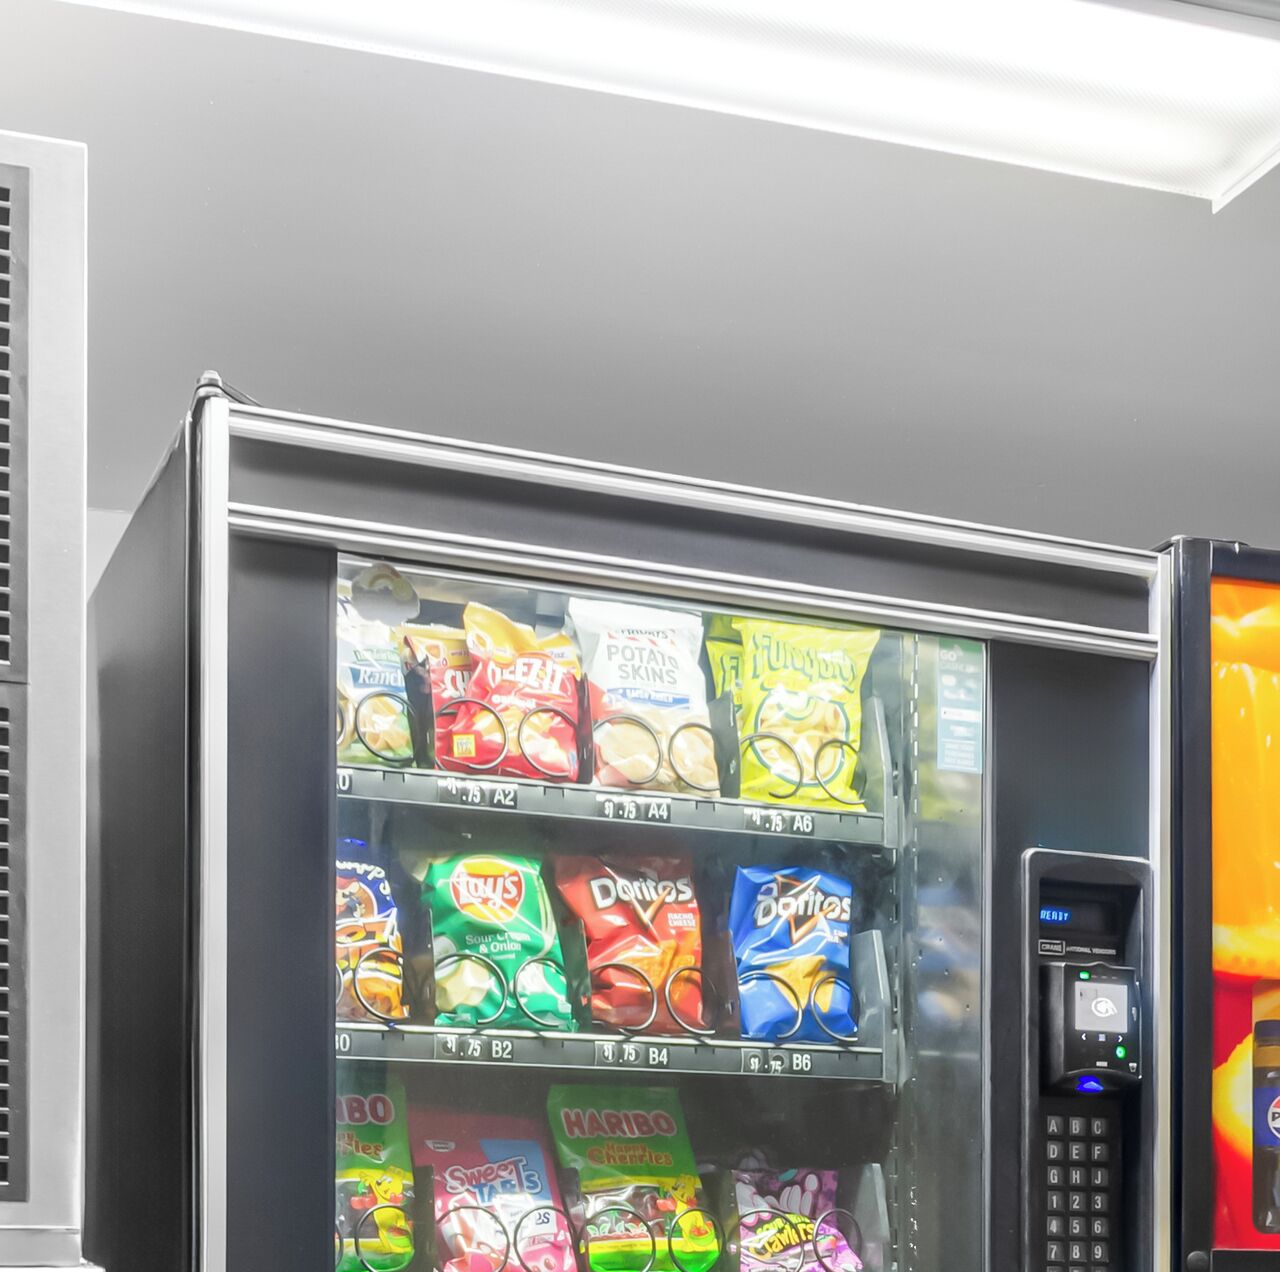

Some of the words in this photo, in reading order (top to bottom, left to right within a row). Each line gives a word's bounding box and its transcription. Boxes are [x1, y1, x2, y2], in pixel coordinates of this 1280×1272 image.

[607, 644, 679, 670] POTATO
[618, 664, 678, 685] SKINS
[336, 772, 350, 791] 0
[494, 788, 515, 806] A2
[648, 801, 668, 820] A4
[792, 814, 813, 833] A6
[590, 877, 693, 910] Doritos
[754, 885, 852, 927] Doritos
[1039, 909, 1069, 921] READY
[466, 933, 493, 946] Sour
[479, 944, 488, 954] &
[491, 941, 522, 953] Onion
[492, 1041, 512, 1059] B2
[649, 1049, 668, 1065] B4
[792, 1054, 811, 1071] B6
[336, 1094, 395, 1124] IBO
[561, 1108, 678, 1138] HARIBO
[1049, 1120, 1058, 1133] A
[1072, 1120, 1081, 1133] B
[1093, 1121, 1102, 1134] C
[605, 1141, 648, 1153] Happy
[1049, 1145, 1058, 1159] D
[1072, 1145, 1081, 1159] E
[1093, 1146, 1102, 1160] F
[587, 1147, 673, 1167] Cherries
[1049, 1169, 1058, 1184] G
[1072, 1169, 1081, 1184] H
[1093, 1170, 1102, 1185] J
[1049, 1195, 1058, 1209] 1
[1072, 1195, 1081, 1209] 2
[1093, 1195, 1102, 1209] 3
[1049, 1220, 1058, 1233] 4
[1072, 1220, 1081, 1233] 5
[1093, 1220, 1102, 1233] 6
[1049, 1245, 1058, 1259] 7
[1072, 1245, 1081, 1259] 8
[1093, 1245, 1102, 1259] 9
